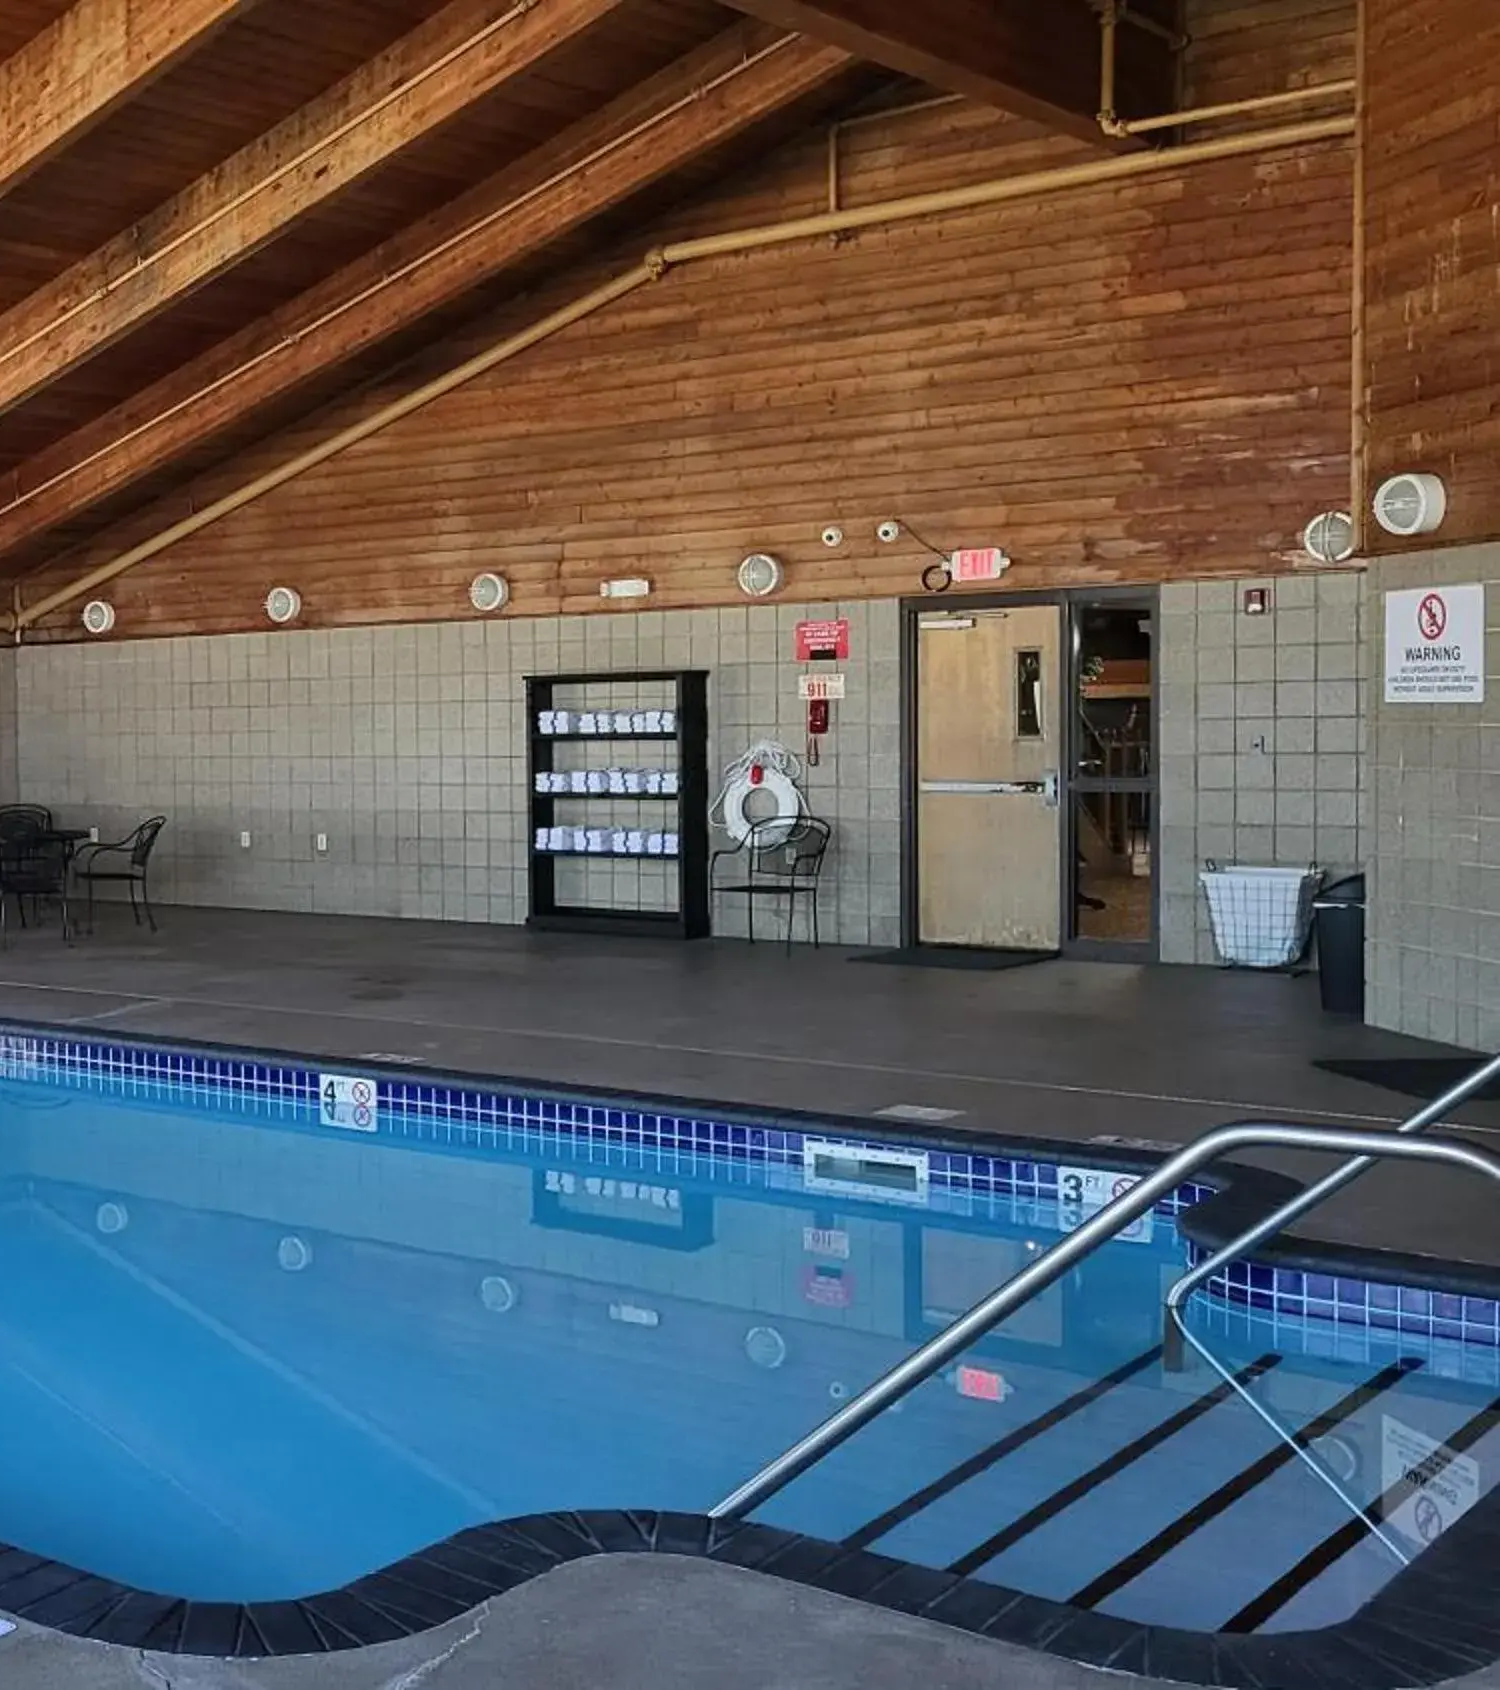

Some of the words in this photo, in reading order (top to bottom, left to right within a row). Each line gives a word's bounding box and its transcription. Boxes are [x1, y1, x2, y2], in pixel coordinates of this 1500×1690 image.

[960, 551, 994, 577] EXIT
[1405, 645, 1461, 661] WARNING
[807, 683, 827, 697] 911
[323, 1080, 337, 1103] 4
[1063, 1173, 1083, 1202] 3
